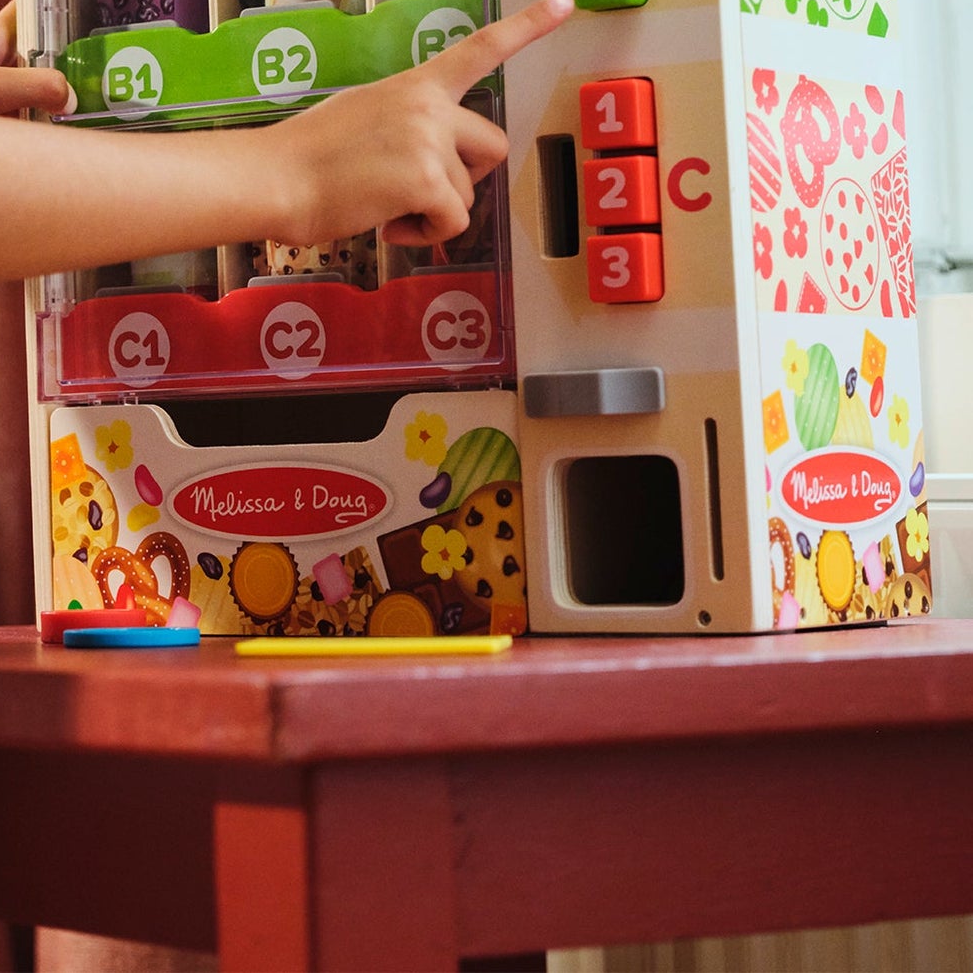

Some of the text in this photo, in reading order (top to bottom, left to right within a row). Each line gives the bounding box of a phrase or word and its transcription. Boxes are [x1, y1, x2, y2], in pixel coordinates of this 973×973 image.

[256, 39, 313, 87] B2
[418, 25, 473, 65] B
[107, 62, 158, 103] B1
[595, 92, 624, 134] 1
[597, 168, 627, 210] 2
[667, 157, 713, 212] C
[601, 246, 630, 288] 3
[113, 331, 166, 368] C1
[264, 320, 322, 359] C2
[426, 309, 486, 351] C3
[190, 485, 285, 522] Melissa
[294, 488, 305, 511] &
[790, 470, 847, 510] Melissa
